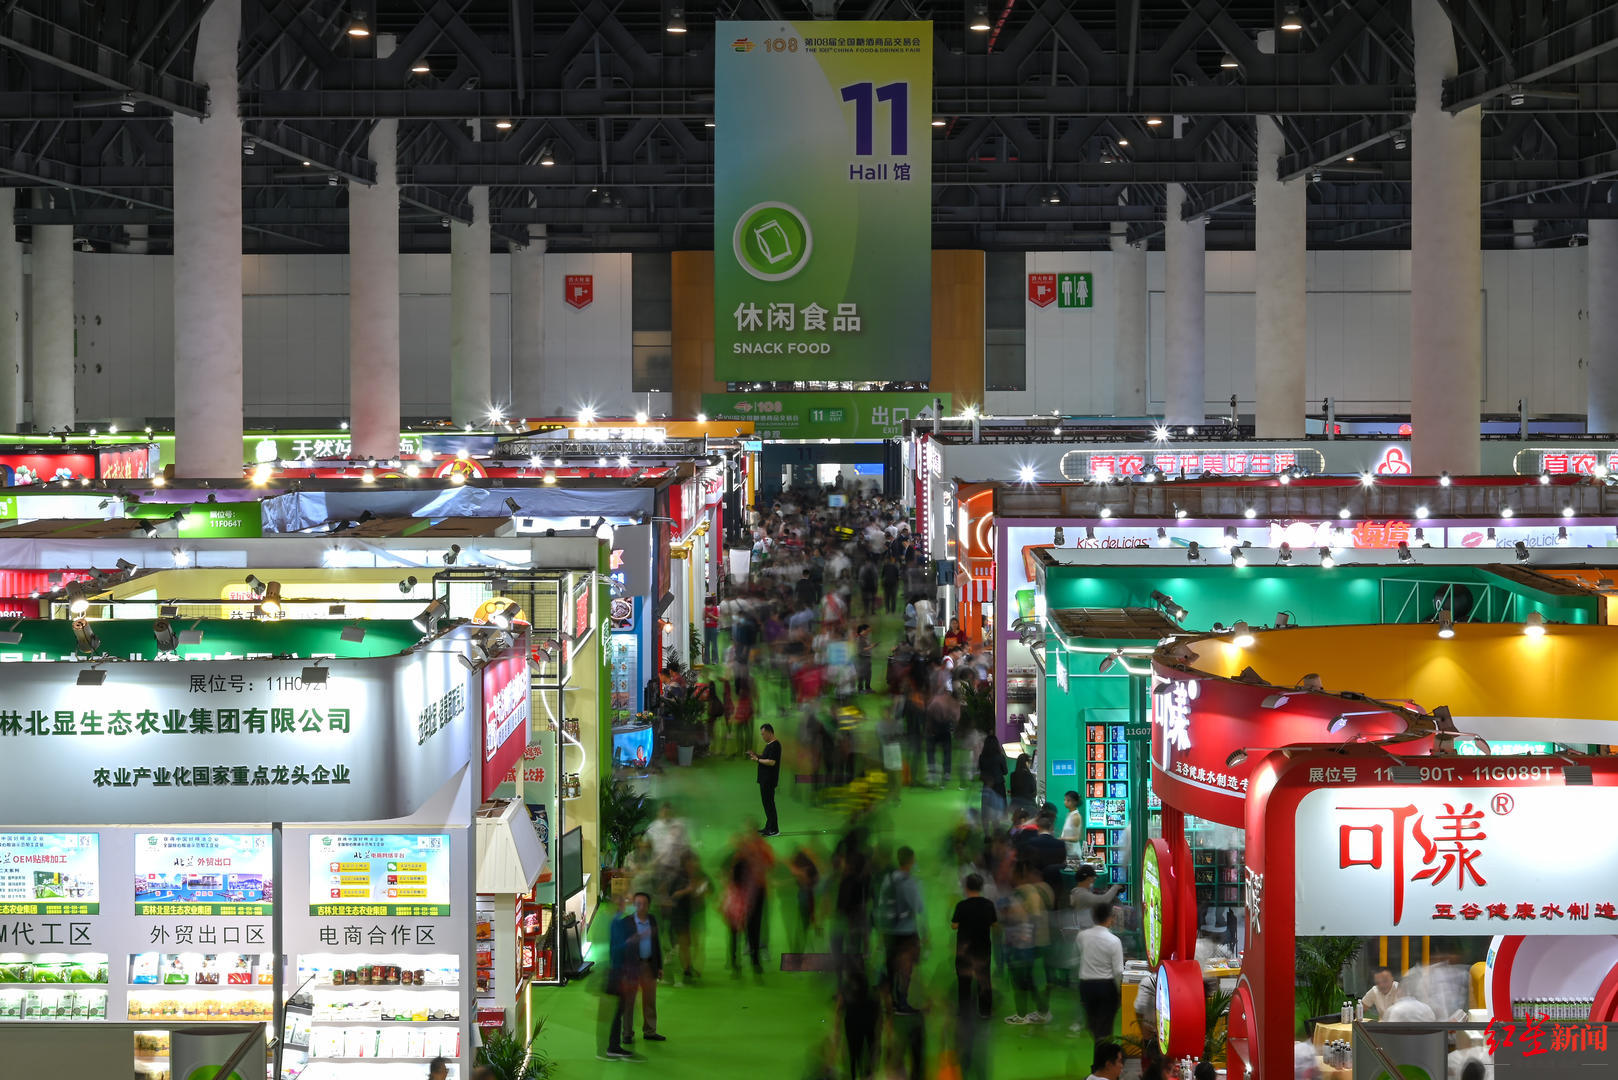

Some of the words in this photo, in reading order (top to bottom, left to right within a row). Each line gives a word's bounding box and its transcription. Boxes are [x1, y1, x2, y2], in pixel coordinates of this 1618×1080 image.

[764, 38, 798, 52] 108
[841, 82, 907, 155] 11
[850, 164, 887, 180] Hall
[893, 162, 911, 181] 馆
[733, 302, 861, 332] 休闲食品
[733, 343, 784, 354] SNACK
[787, 343, 831, 354] FOOD
[813, 410, 824, 421] 11
[871, 405, 910, 426] 出口
[1156, 453, 1296, 474] 守护美好生活
[1544, 454, 1598, 475] 首农
[189, 674, 254, 693] 展位号：
[0, 707, 350, 737] 林北显生态农业集团有限公司
[92, 764, 350, 788] 农业产业化国家重点龙头企业
[1308, 766, 1358, 783] 展位号
[13, 854, 67, 864] OEM贴牌加工
[197, 857, 232, 867] 外贸出口
[1431, 902, 1618, 921] 五谷健康水制造
[150, 925, 265, 946] 外贸出口区
[319, 925, 436, 946] 电商合作区
